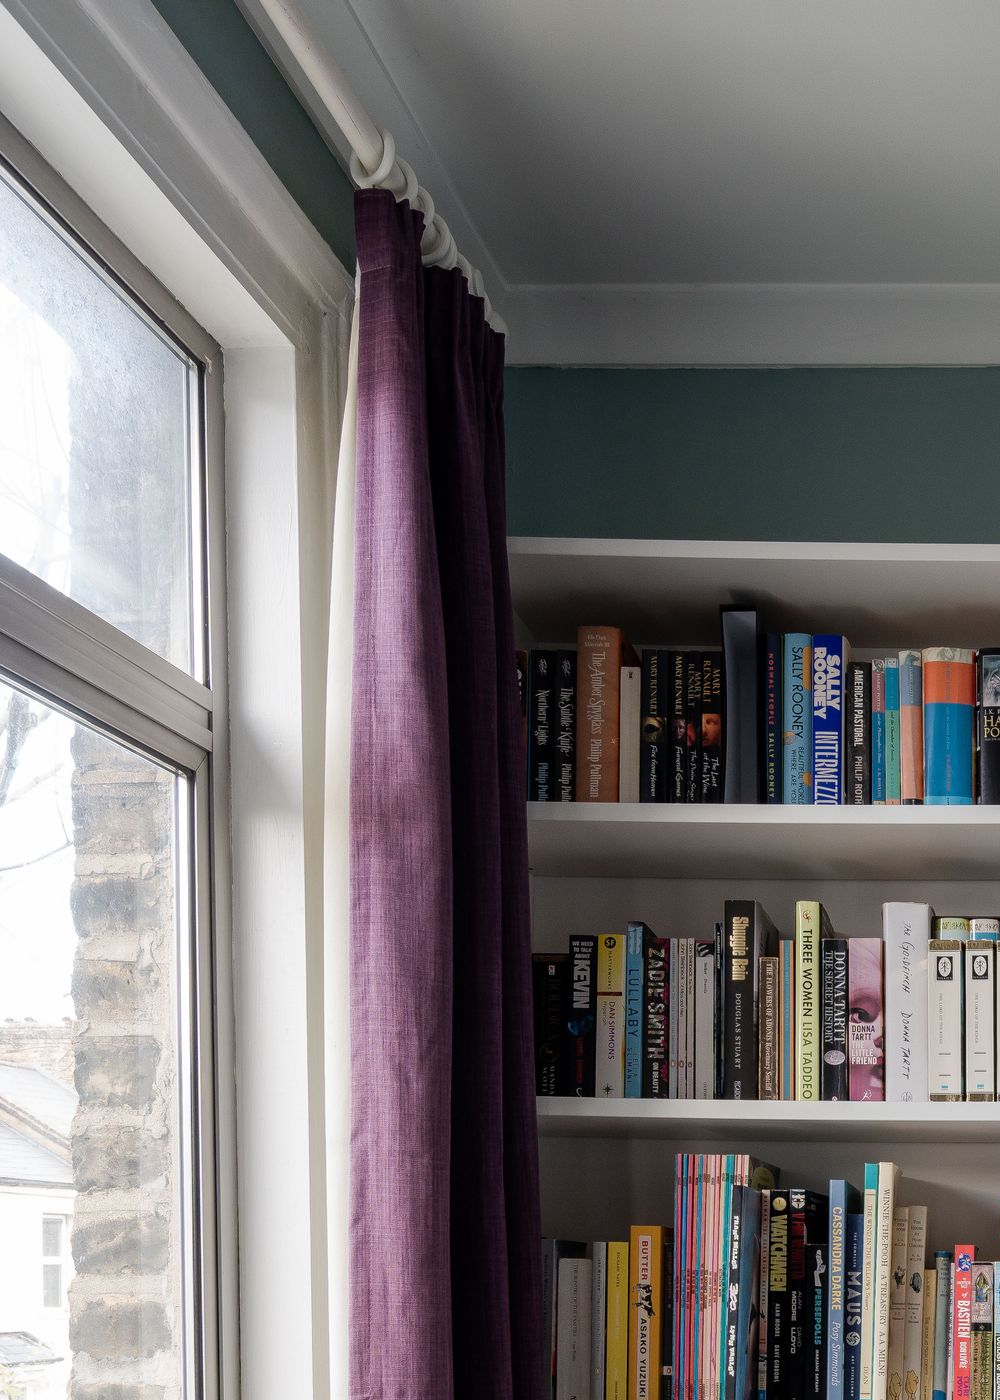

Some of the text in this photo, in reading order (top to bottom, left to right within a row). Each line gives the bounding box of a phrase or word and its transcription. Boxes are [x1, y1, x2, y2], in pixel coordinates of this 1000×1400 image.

[586, 651, 606, 734] The Amber Spyglass
[792, 646, 804, 738] SALLY ROONEY
[814, 647, 827, 719] ROONEY
[826, 654, 840, 710] SALLY
[534, 690, 550, 746] Northern Lights
[556, 688, 573, 757] The Subtle Knife
[854, 670, 863, 805] AMERICAN PASTORAL PHILIP ROTH
[587, 738, 602, 797] Philip Pullman
[572, 960, 590, 1008] KEVIN
[628, 968, 639, 1038] LULLABY
[648, 948, 664, 996] ZADIE
[730, 916, 749, 1070] Shuggie Bain DOUGLAS STUART
[824, 950, 833, 1044] THE SECRET HISTORY
[834, 951, 846, 1044] DONNA TARTT
[608, 1002, 616, 1060] DAN SIMMONS
[648, 1002, 664, 1058] SMITH
[802, 929, 812, 1100] THREE WOMEN LISA TADDEO
[652, 1062, 659, 1070] ON
[770, 1215, 787, 1292] WATCHMEN
[881, 1189, 890, 1266] WINNIE-THE-POOH
[641, 1240, 649, 1280] BUTTER
[814, 1288, 822, 1344] PERSEPOLIS
[830, 1206, 842, 1386] CASSANDRA DARKE Posy Simmonds
[846, 1271, 861, 1326] MAUS
[879, 1282, 888, 1326] TREASURY
[958, 1300, 970, 1338] BASTIEN
[639, 1318, 647, 1398] ASAKO YUZUKI
[878, 1348, 886, 1376] MILNE
